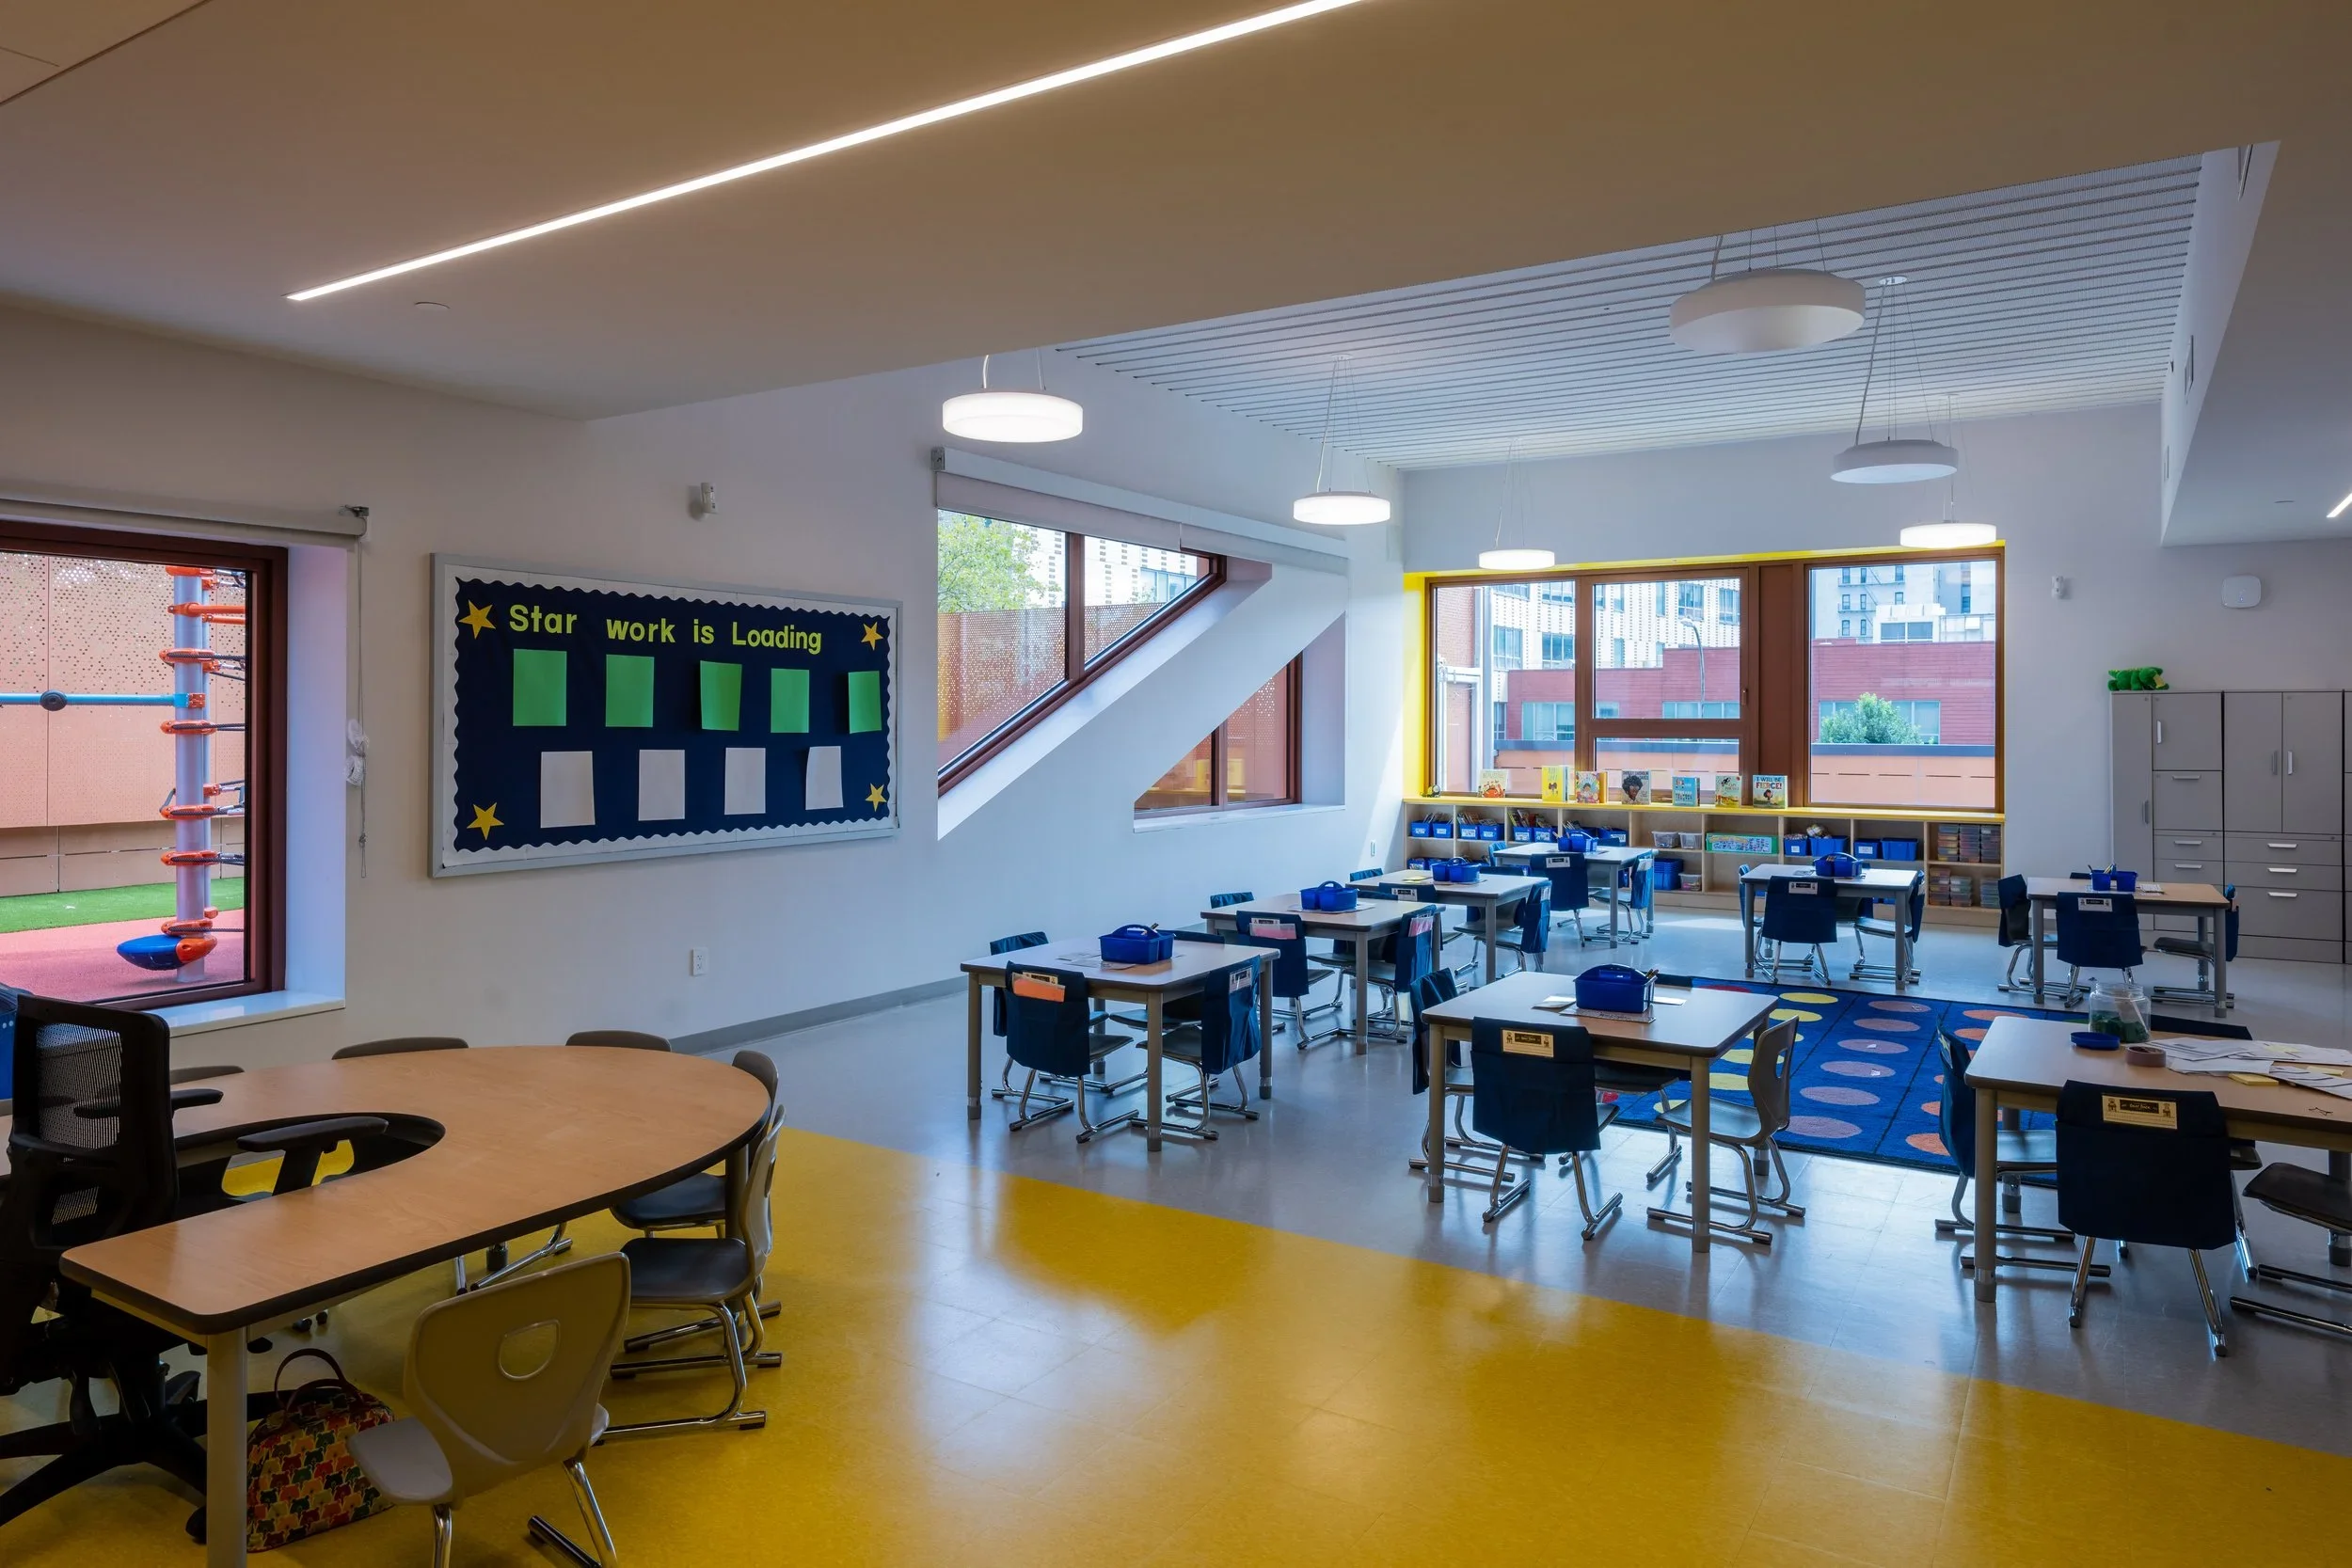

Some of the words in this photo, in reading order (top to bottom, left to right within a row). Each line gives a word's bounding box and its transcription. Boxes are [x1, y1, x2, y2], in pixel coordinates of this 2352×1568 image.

[509, 604, 578, 634] Star
[606, 618, 675, 643] work
[693, 618, 715, 644] is
[732, 622, 822, 656] Loading
